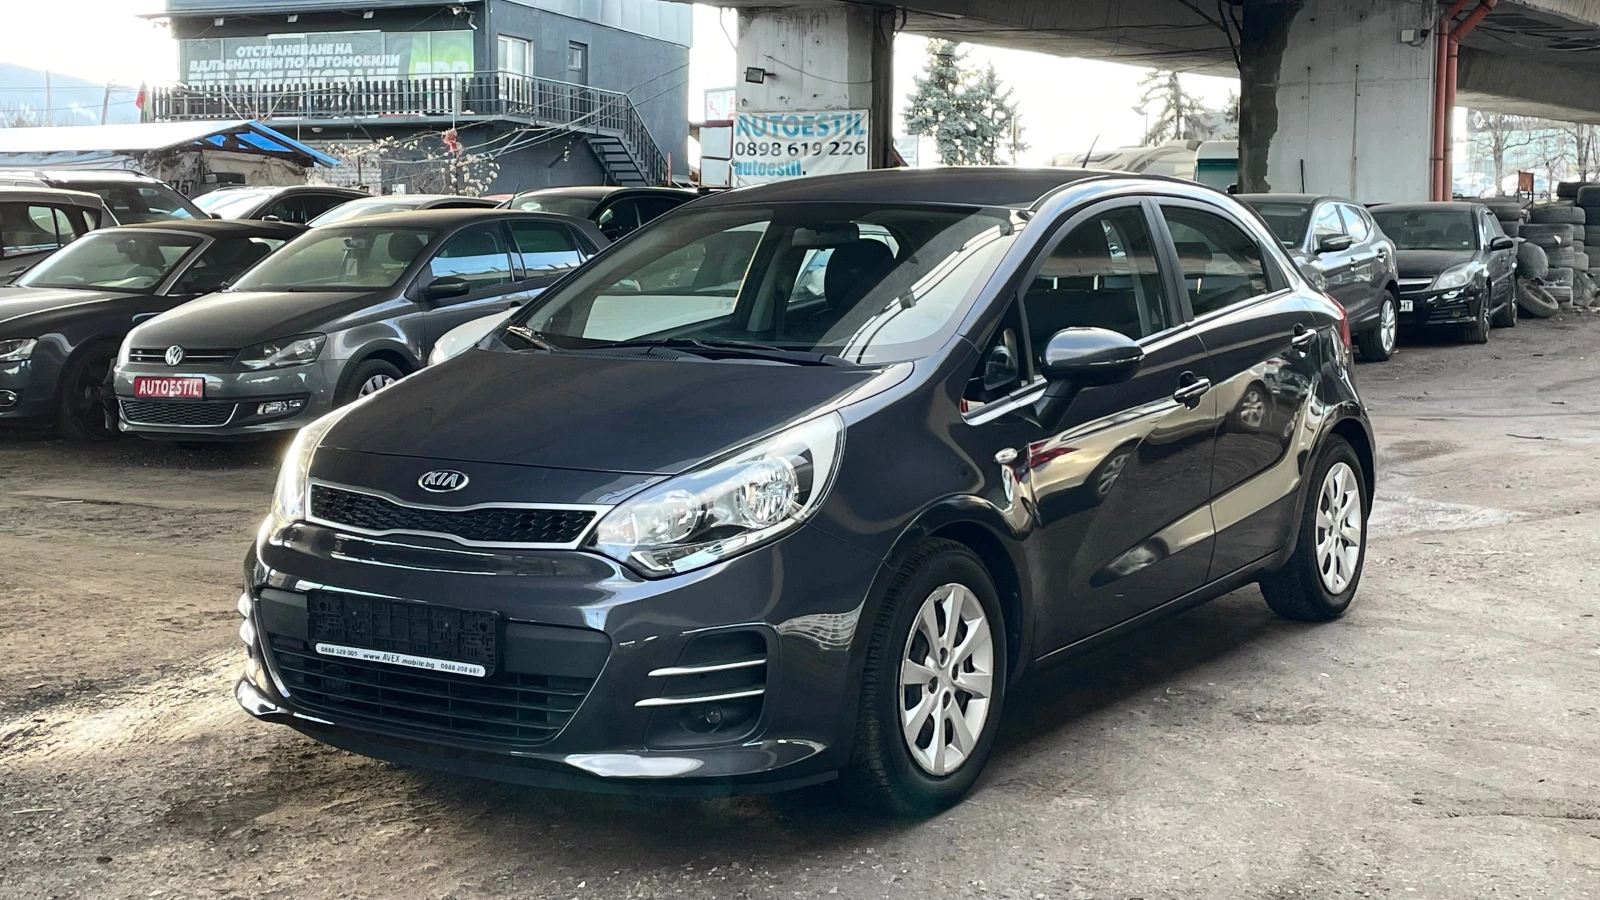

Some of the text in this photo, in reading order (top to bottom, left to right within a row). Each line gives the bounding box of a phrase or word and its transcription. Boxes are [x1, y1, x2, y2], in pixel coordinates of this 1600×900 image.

[236, 43, 353, 58] ОТСТРАНЯВАНЕ НА
[284, 56, 305, 69] ПО
[306, 54, 400, 69] АВТОМОБИЛИ
[736, 113, 867, 138] AUTOESTIL
[735, 140, 866, 157] 0898 619 226
[139, 380, 199, 395] AUTOESTIL
[424, 471, 459, 488] KIA
